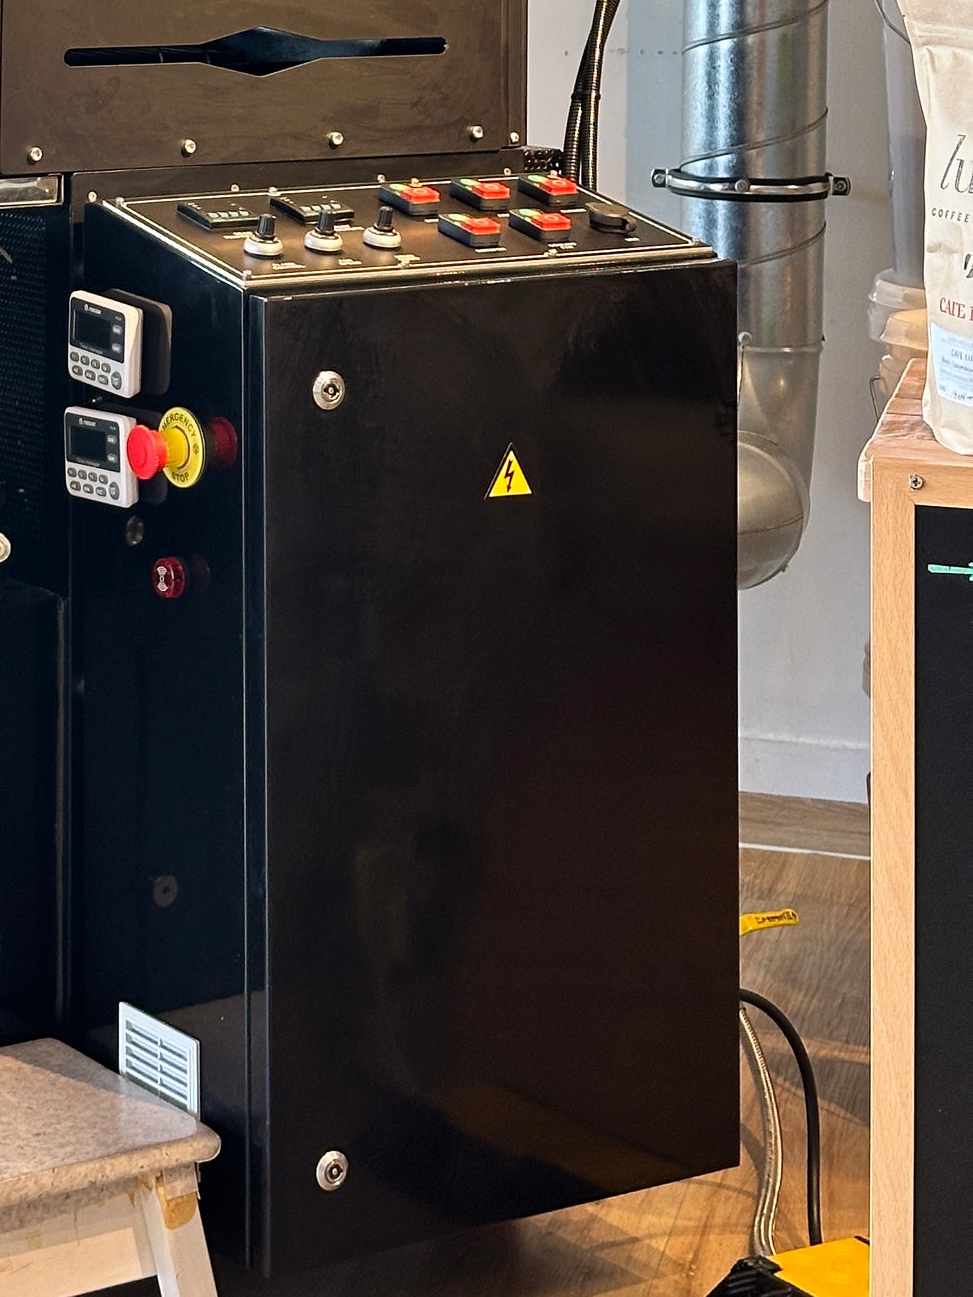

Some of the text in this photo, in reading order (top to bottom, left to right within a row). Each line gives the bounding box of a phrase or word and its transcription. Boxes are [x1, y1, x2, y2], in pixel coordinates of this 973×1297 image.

[940, 134, 973, 194] lu
[931, 206, 970, 223] COFFEE
[939, 297, 966, 319] CAFE
[162, 412, 196, 437] MERGENCY
[172, 471, 189, 483] STOP
